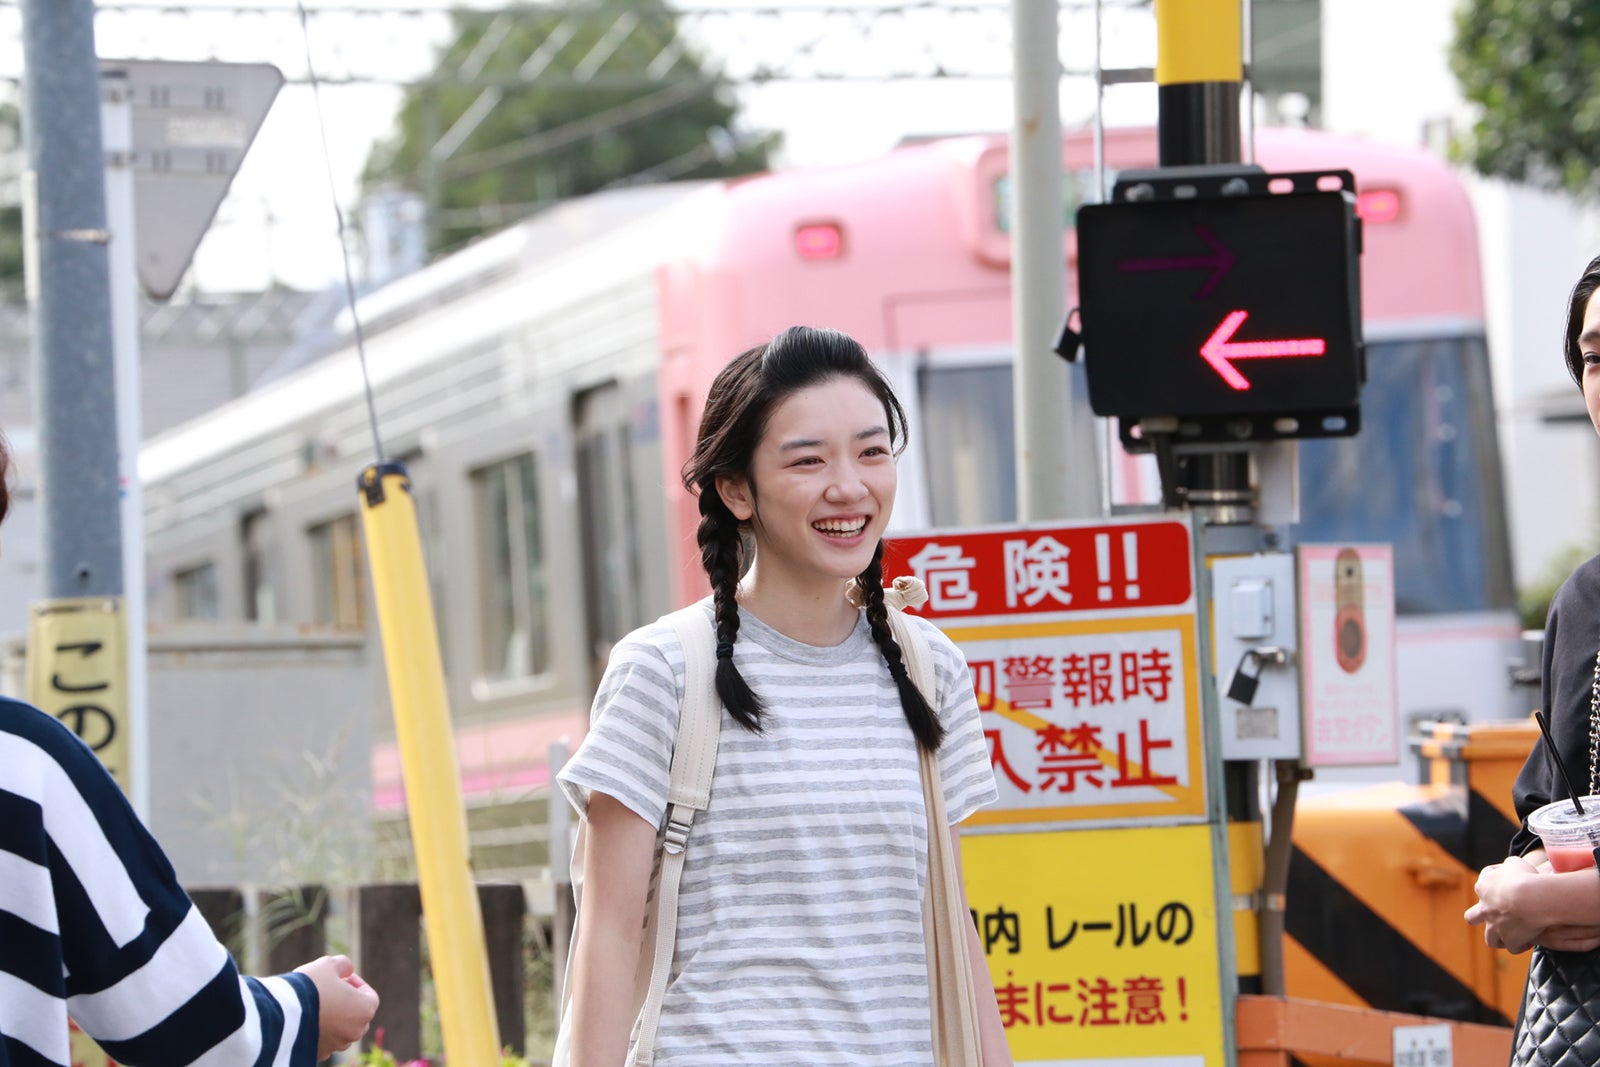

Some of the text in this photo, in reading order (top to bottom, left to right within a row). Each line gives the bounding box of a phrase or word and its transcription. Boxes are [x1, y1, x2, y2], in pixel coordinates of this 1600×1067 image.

[907, 531, 1141, 612] 危険!!
[52, 641, 117, 777] この
[969, 901, 1194, 955] 内 レールの
